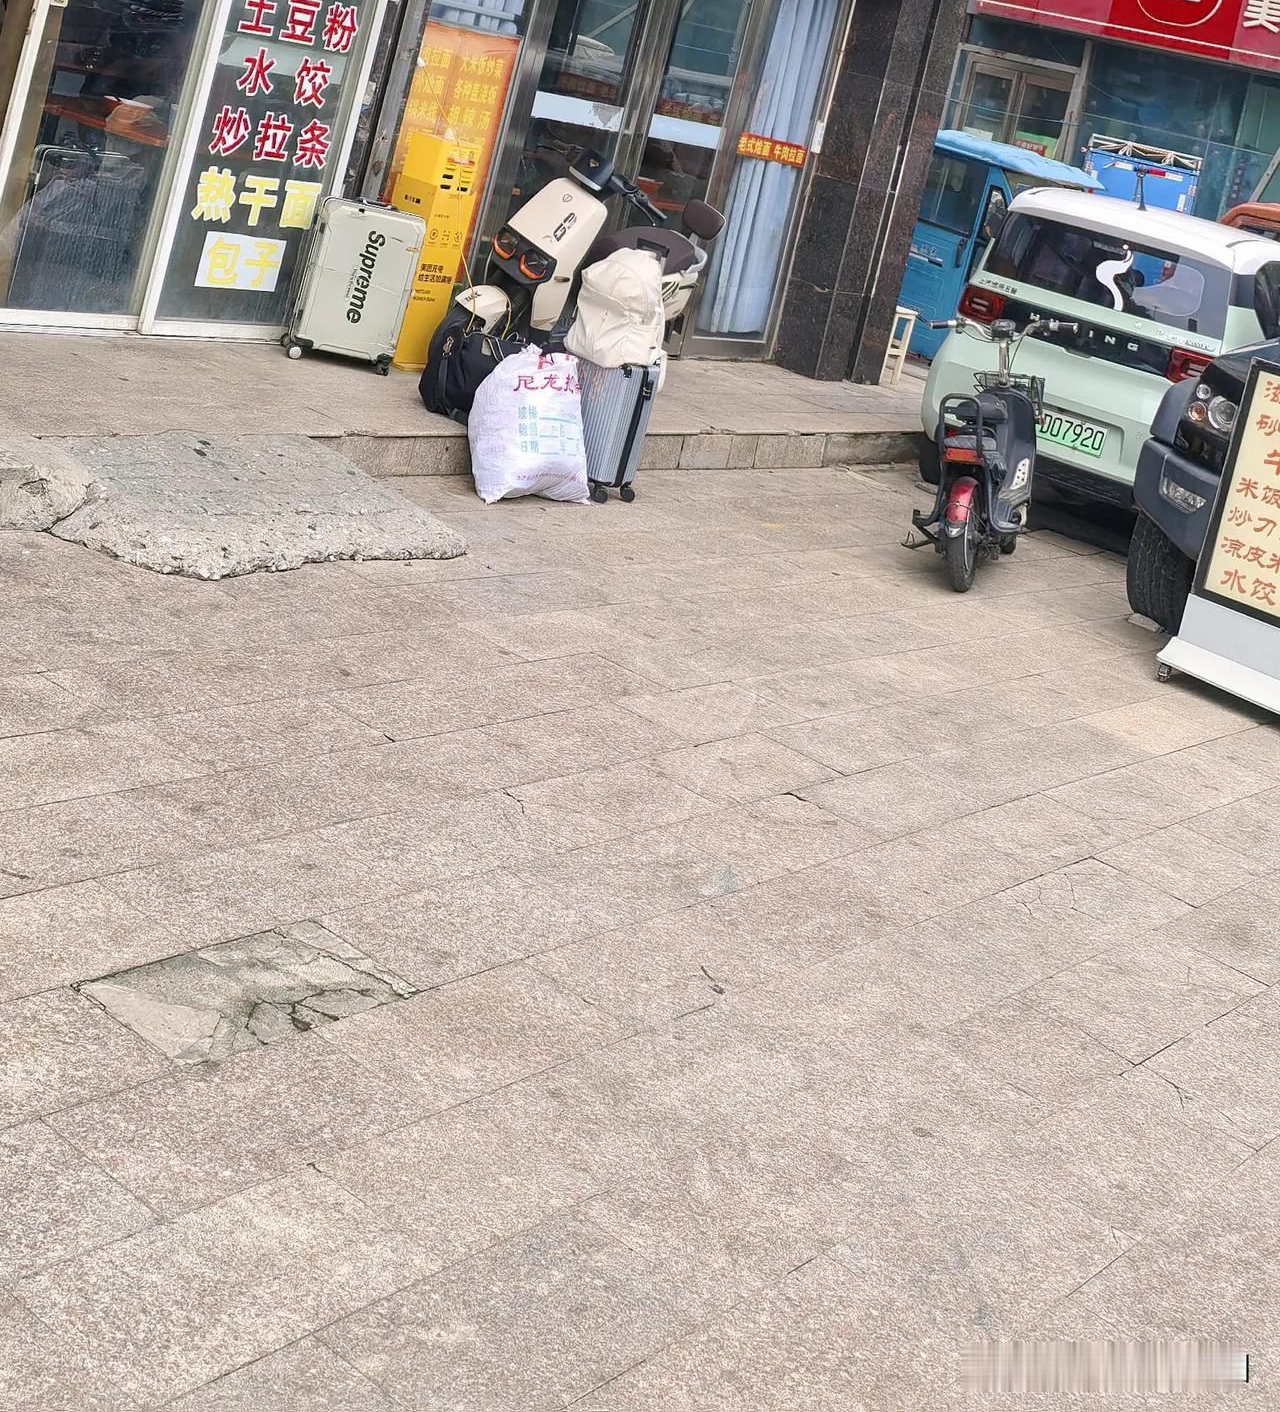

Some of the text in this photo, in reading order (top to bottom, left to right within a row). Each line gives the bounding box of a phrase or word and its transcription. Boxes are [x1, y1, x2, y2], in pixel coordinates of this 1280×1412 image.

[235, 46, 333, 108] 水饺
[209, 106, 331, 169] 炒拉条
[737, 136, 805, 165] 老式烩面 牛肉拉面
[191, 166, 322, 230] 热干面
[206, 235, 280, 287] 包子
[346, 230, 386, 324] Supreme
[1040, 413, 1106, 451] D07920
[1220, 568, 1277, 607] 水饺
